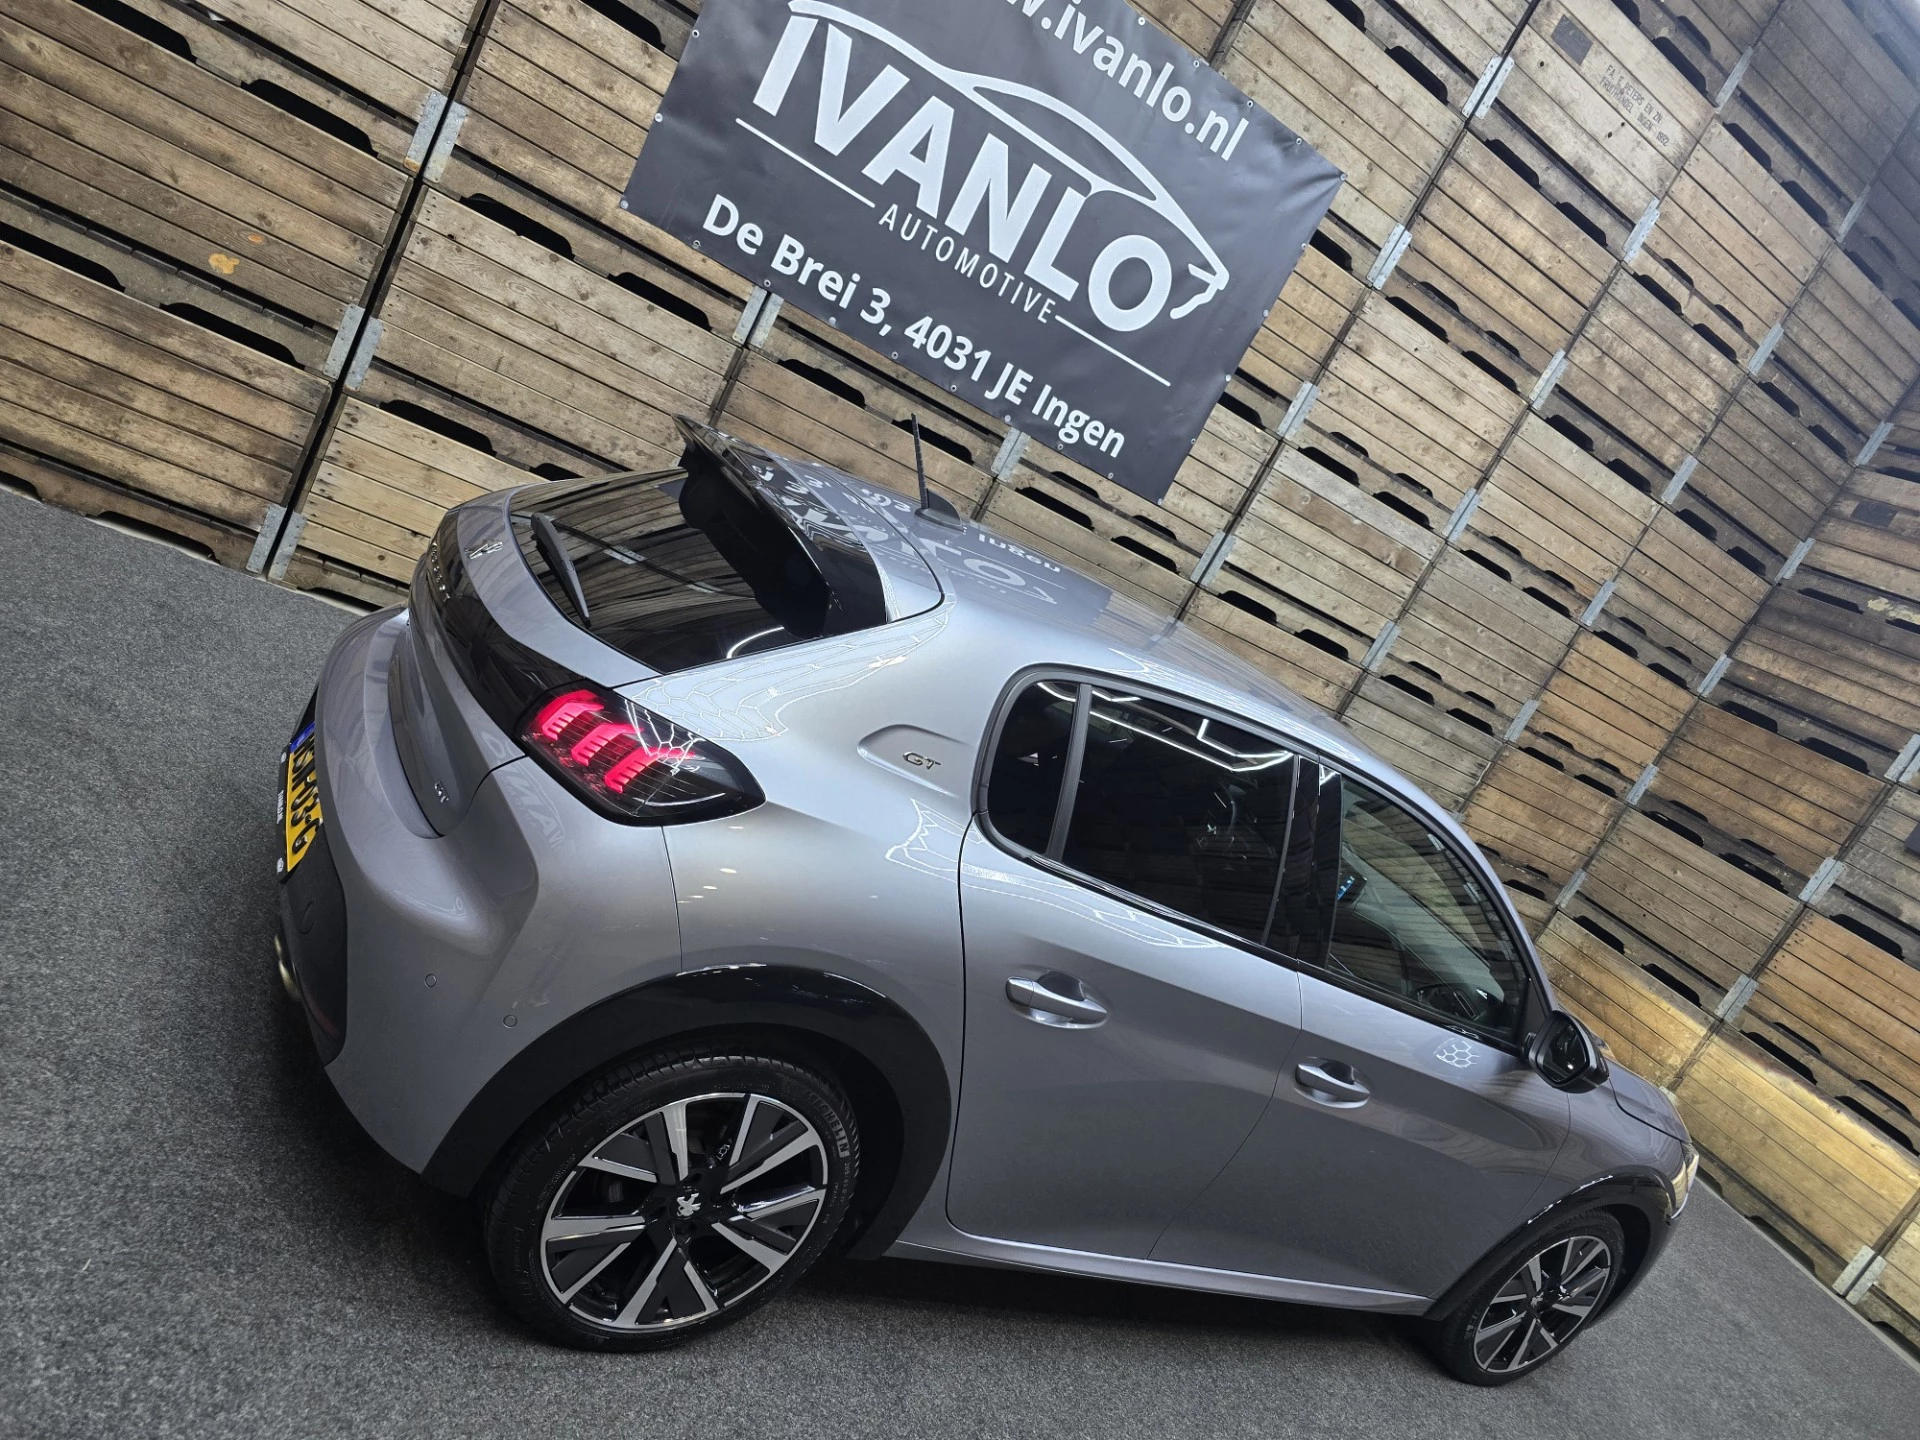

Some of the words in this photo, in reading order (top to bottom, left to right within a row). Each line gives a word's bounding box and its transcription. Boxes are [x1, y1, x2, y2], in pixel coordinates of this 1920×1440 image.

[1623, 81, 1645, 106] PETERS
[753, 15, 1172, 332] IVANLO
[878, 203, 1056, 324] AUTOMOTIVE
[702, 193, 764, 255] De
[770, 233, 861, 309] Brei
[859, 287, 893, 337] 3,
[903, 316, 992, 382] 4031
[984, 362, 1034, 405] JE
[1031, 384, 1125, 458] Ingen
[902, 751, 941, 770] GT
